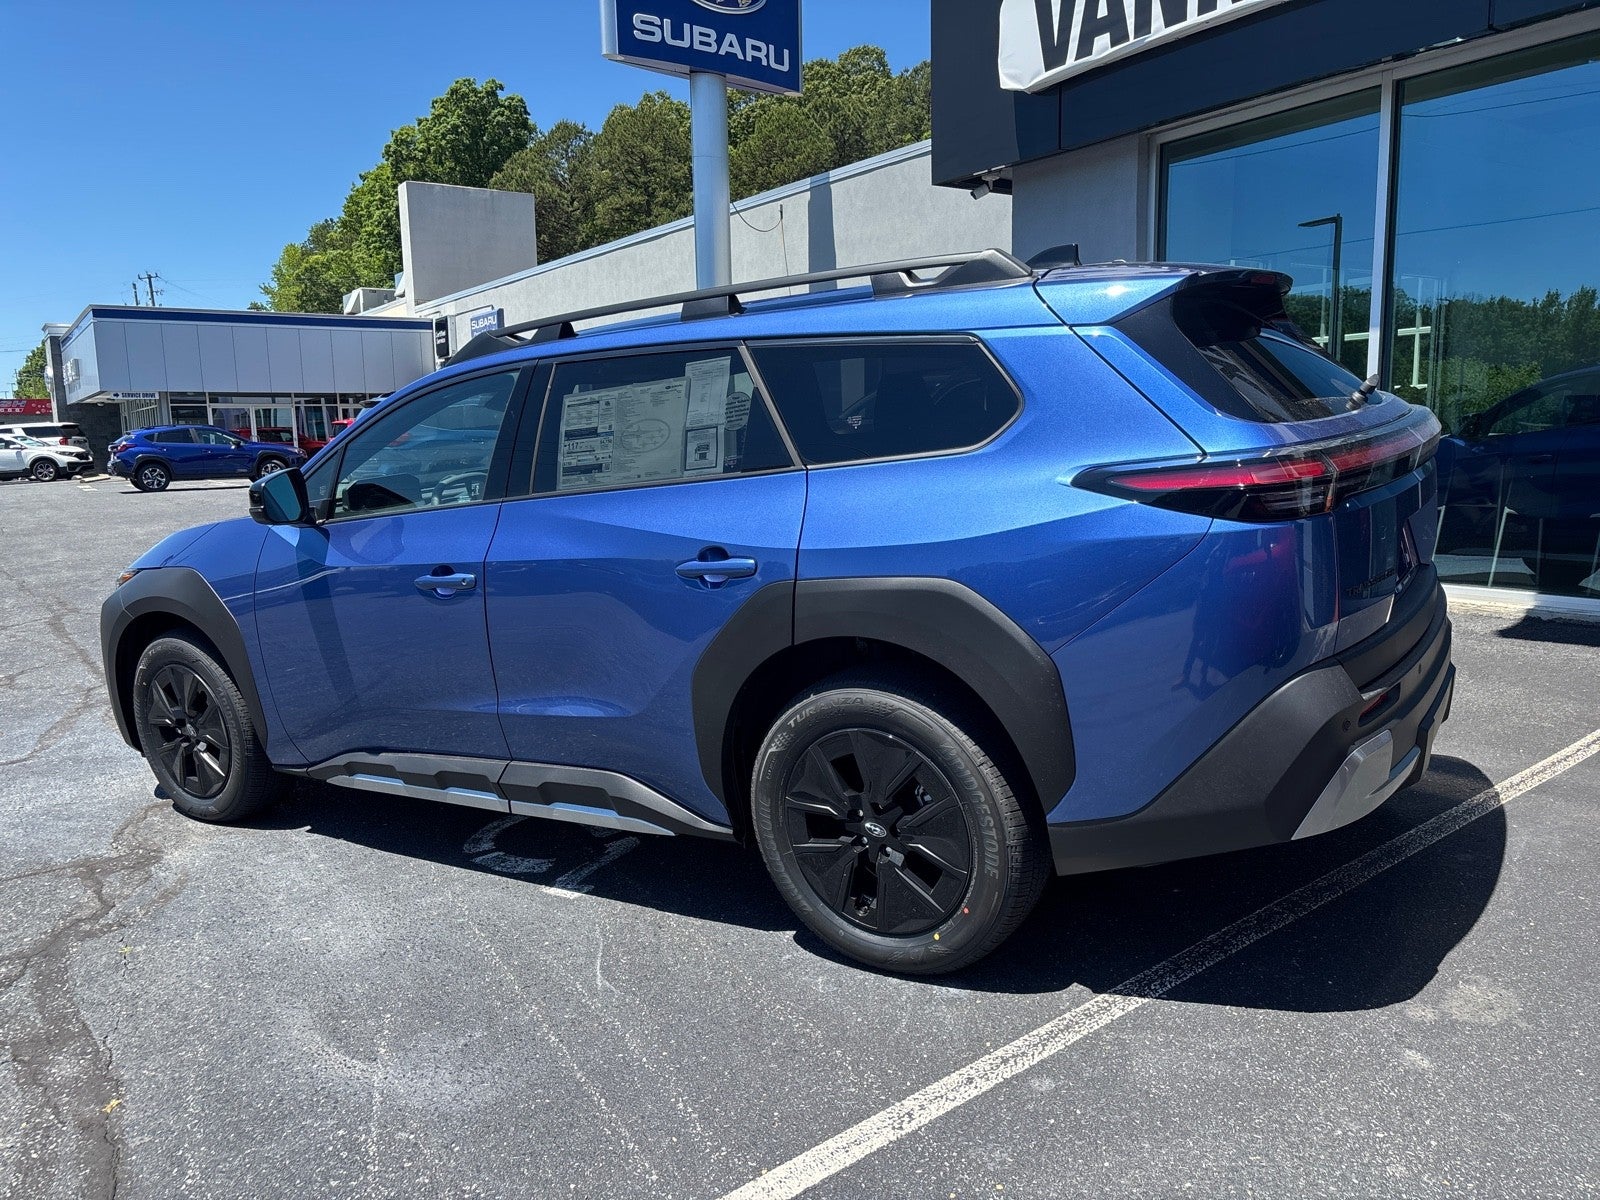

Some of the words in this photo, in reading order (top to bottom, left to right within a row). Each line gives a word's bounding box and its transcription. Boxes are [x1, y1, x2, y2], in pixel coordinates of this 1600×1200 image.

[632, 12, 790, 73] SUBARU
[471, 314, 497, 330] SUBARU
[787, 697, 865, 729] TURANZA
